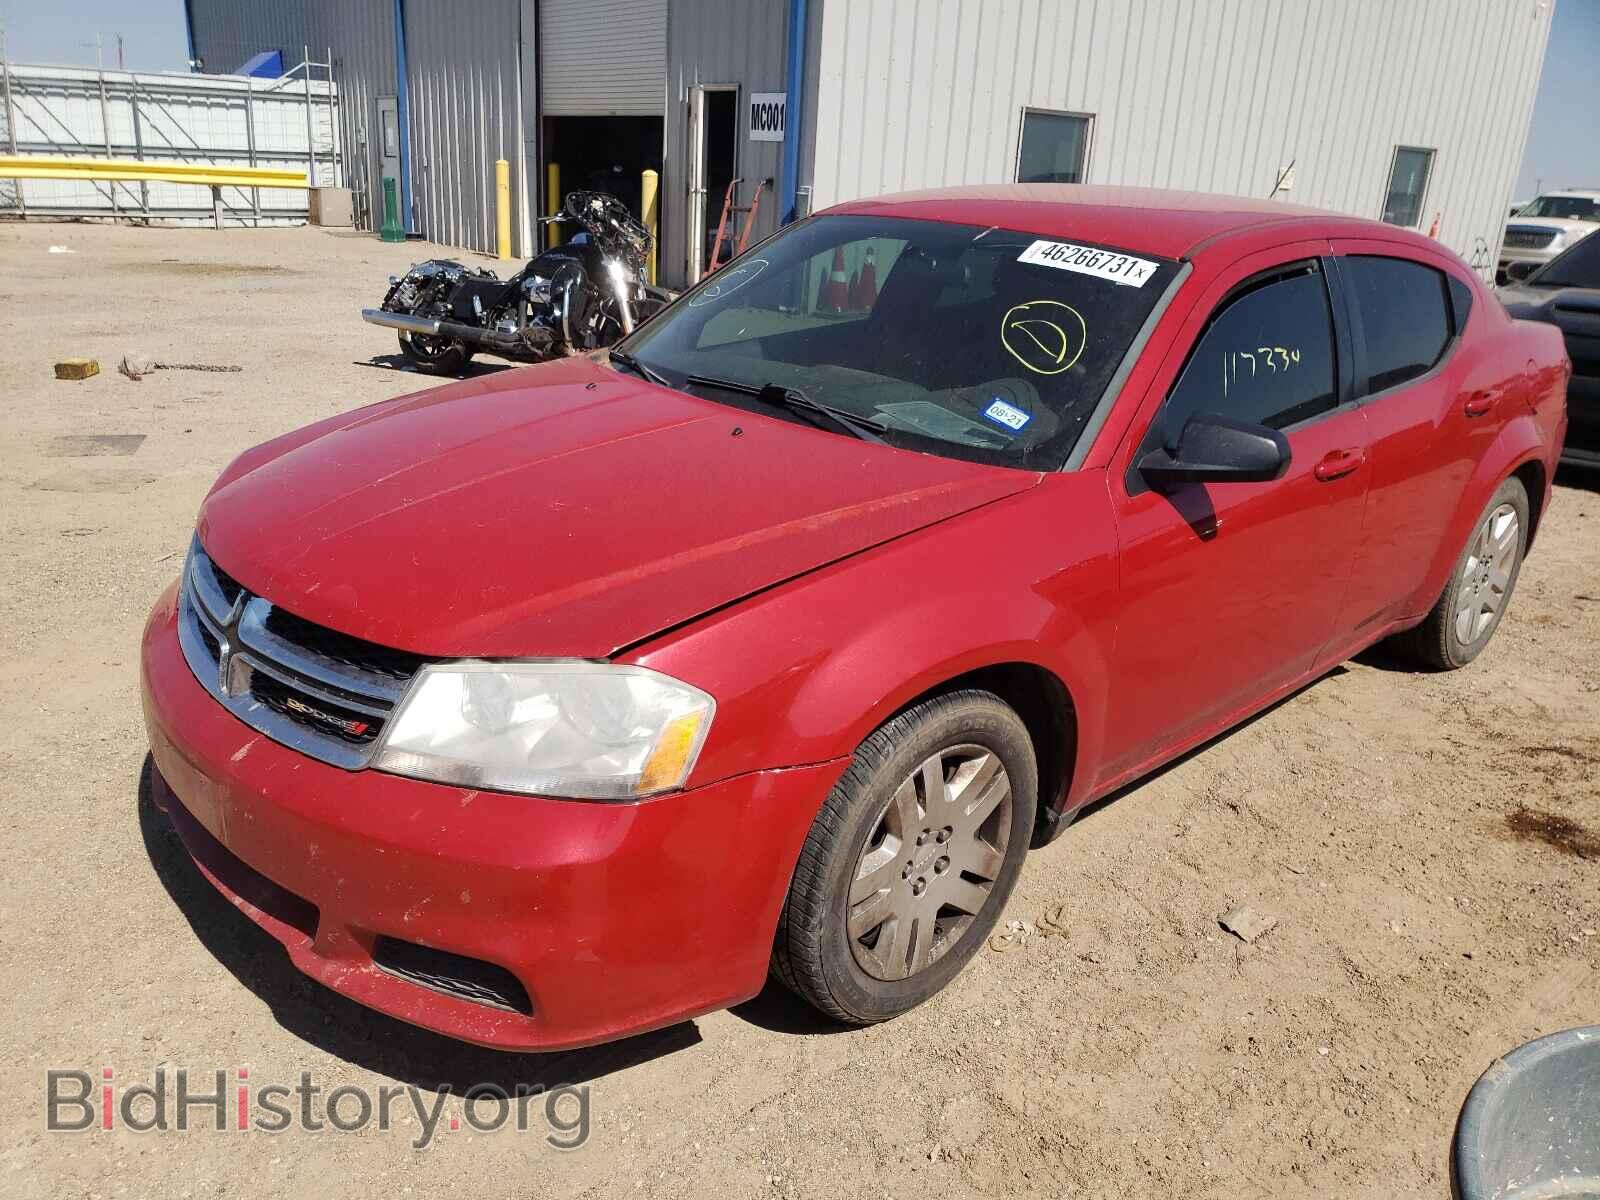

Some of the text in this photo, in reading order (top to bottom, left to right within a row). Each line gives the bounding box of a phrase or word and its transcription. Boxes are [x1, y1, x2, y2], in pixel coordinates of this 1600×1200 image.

[752, 102, 785, 131] MC001
[1040, 244, 1139, 277] 46266731
[287, 697, 357, 732] DODGE
